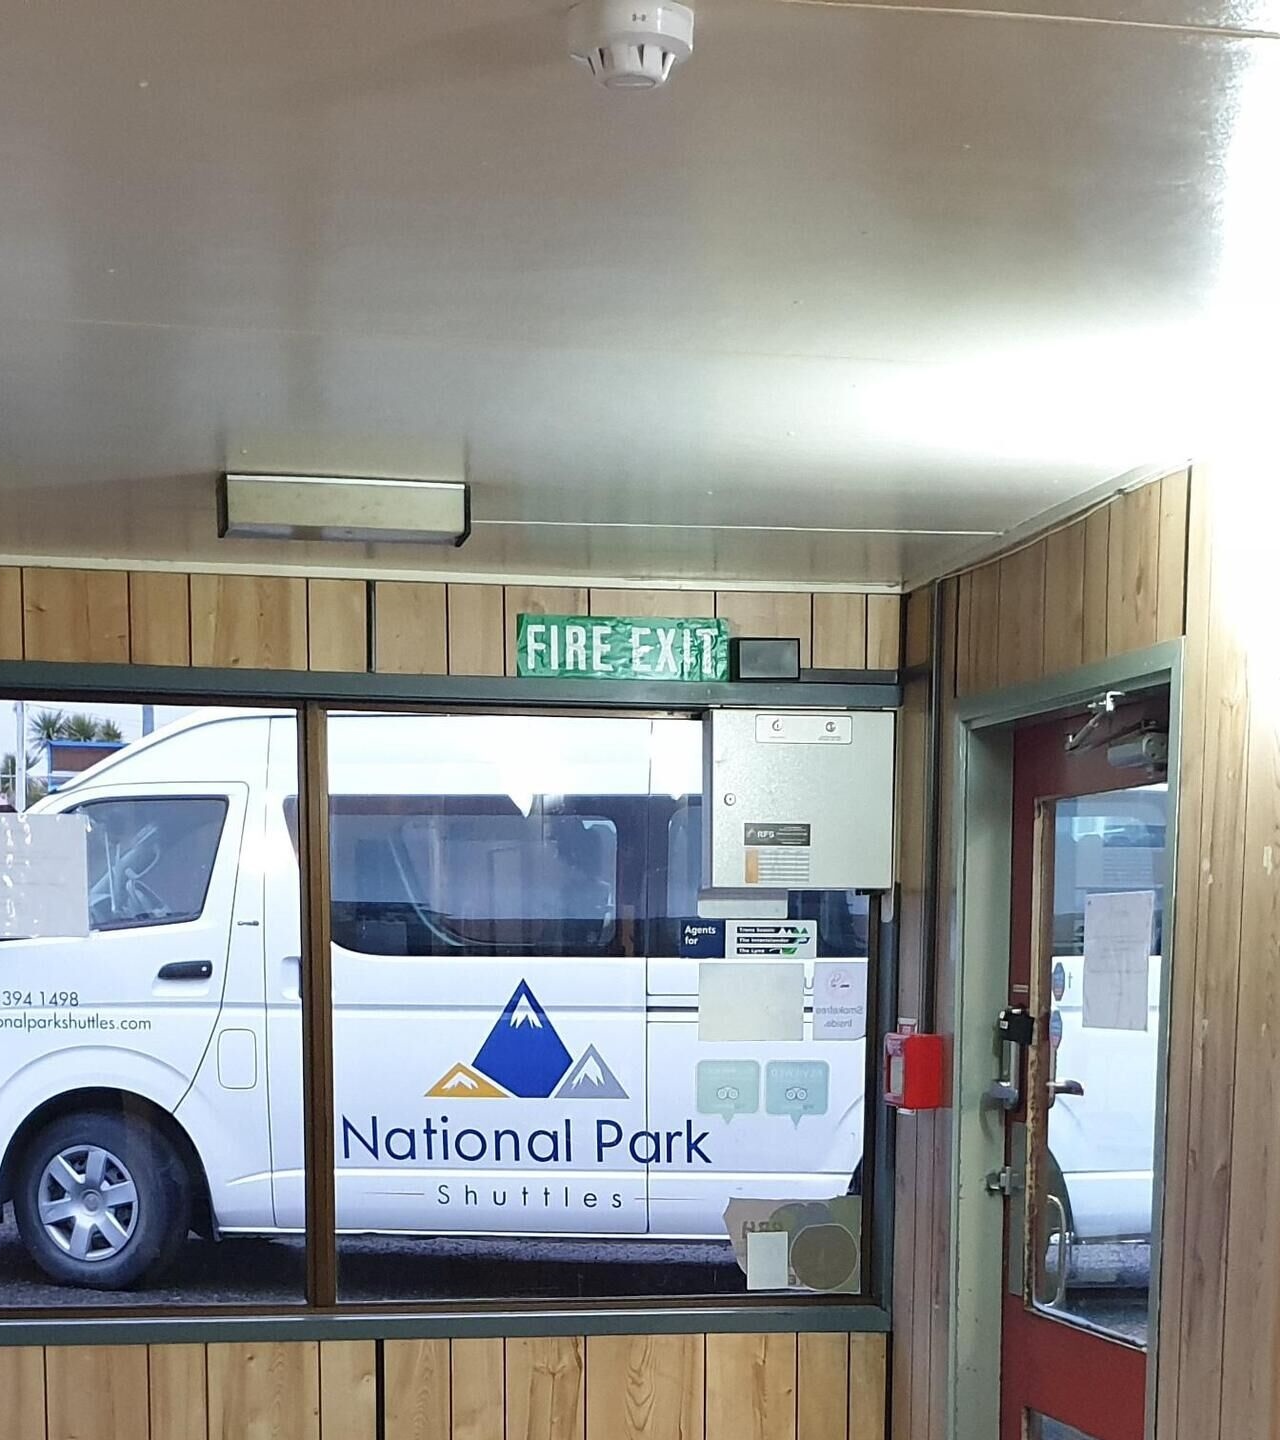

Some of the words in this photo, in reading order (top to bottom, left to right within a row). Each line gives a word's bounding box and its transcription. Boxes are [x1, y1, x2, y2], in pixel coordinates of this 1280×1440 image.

[526, 624, 615, 672] FIRE
[628, 626, 719, 681] EXIT
[684, 925, 716, 935] Agents
[684, 936, 698, 945] for
[2, 991, 32, 1007] 394
[39, 991, 80, 1007] 1498
[341, 1115, 573, 1163] National
[596, 1119, 713, 1164] Park
[436, 1184, 622, 1209] Shuttles
